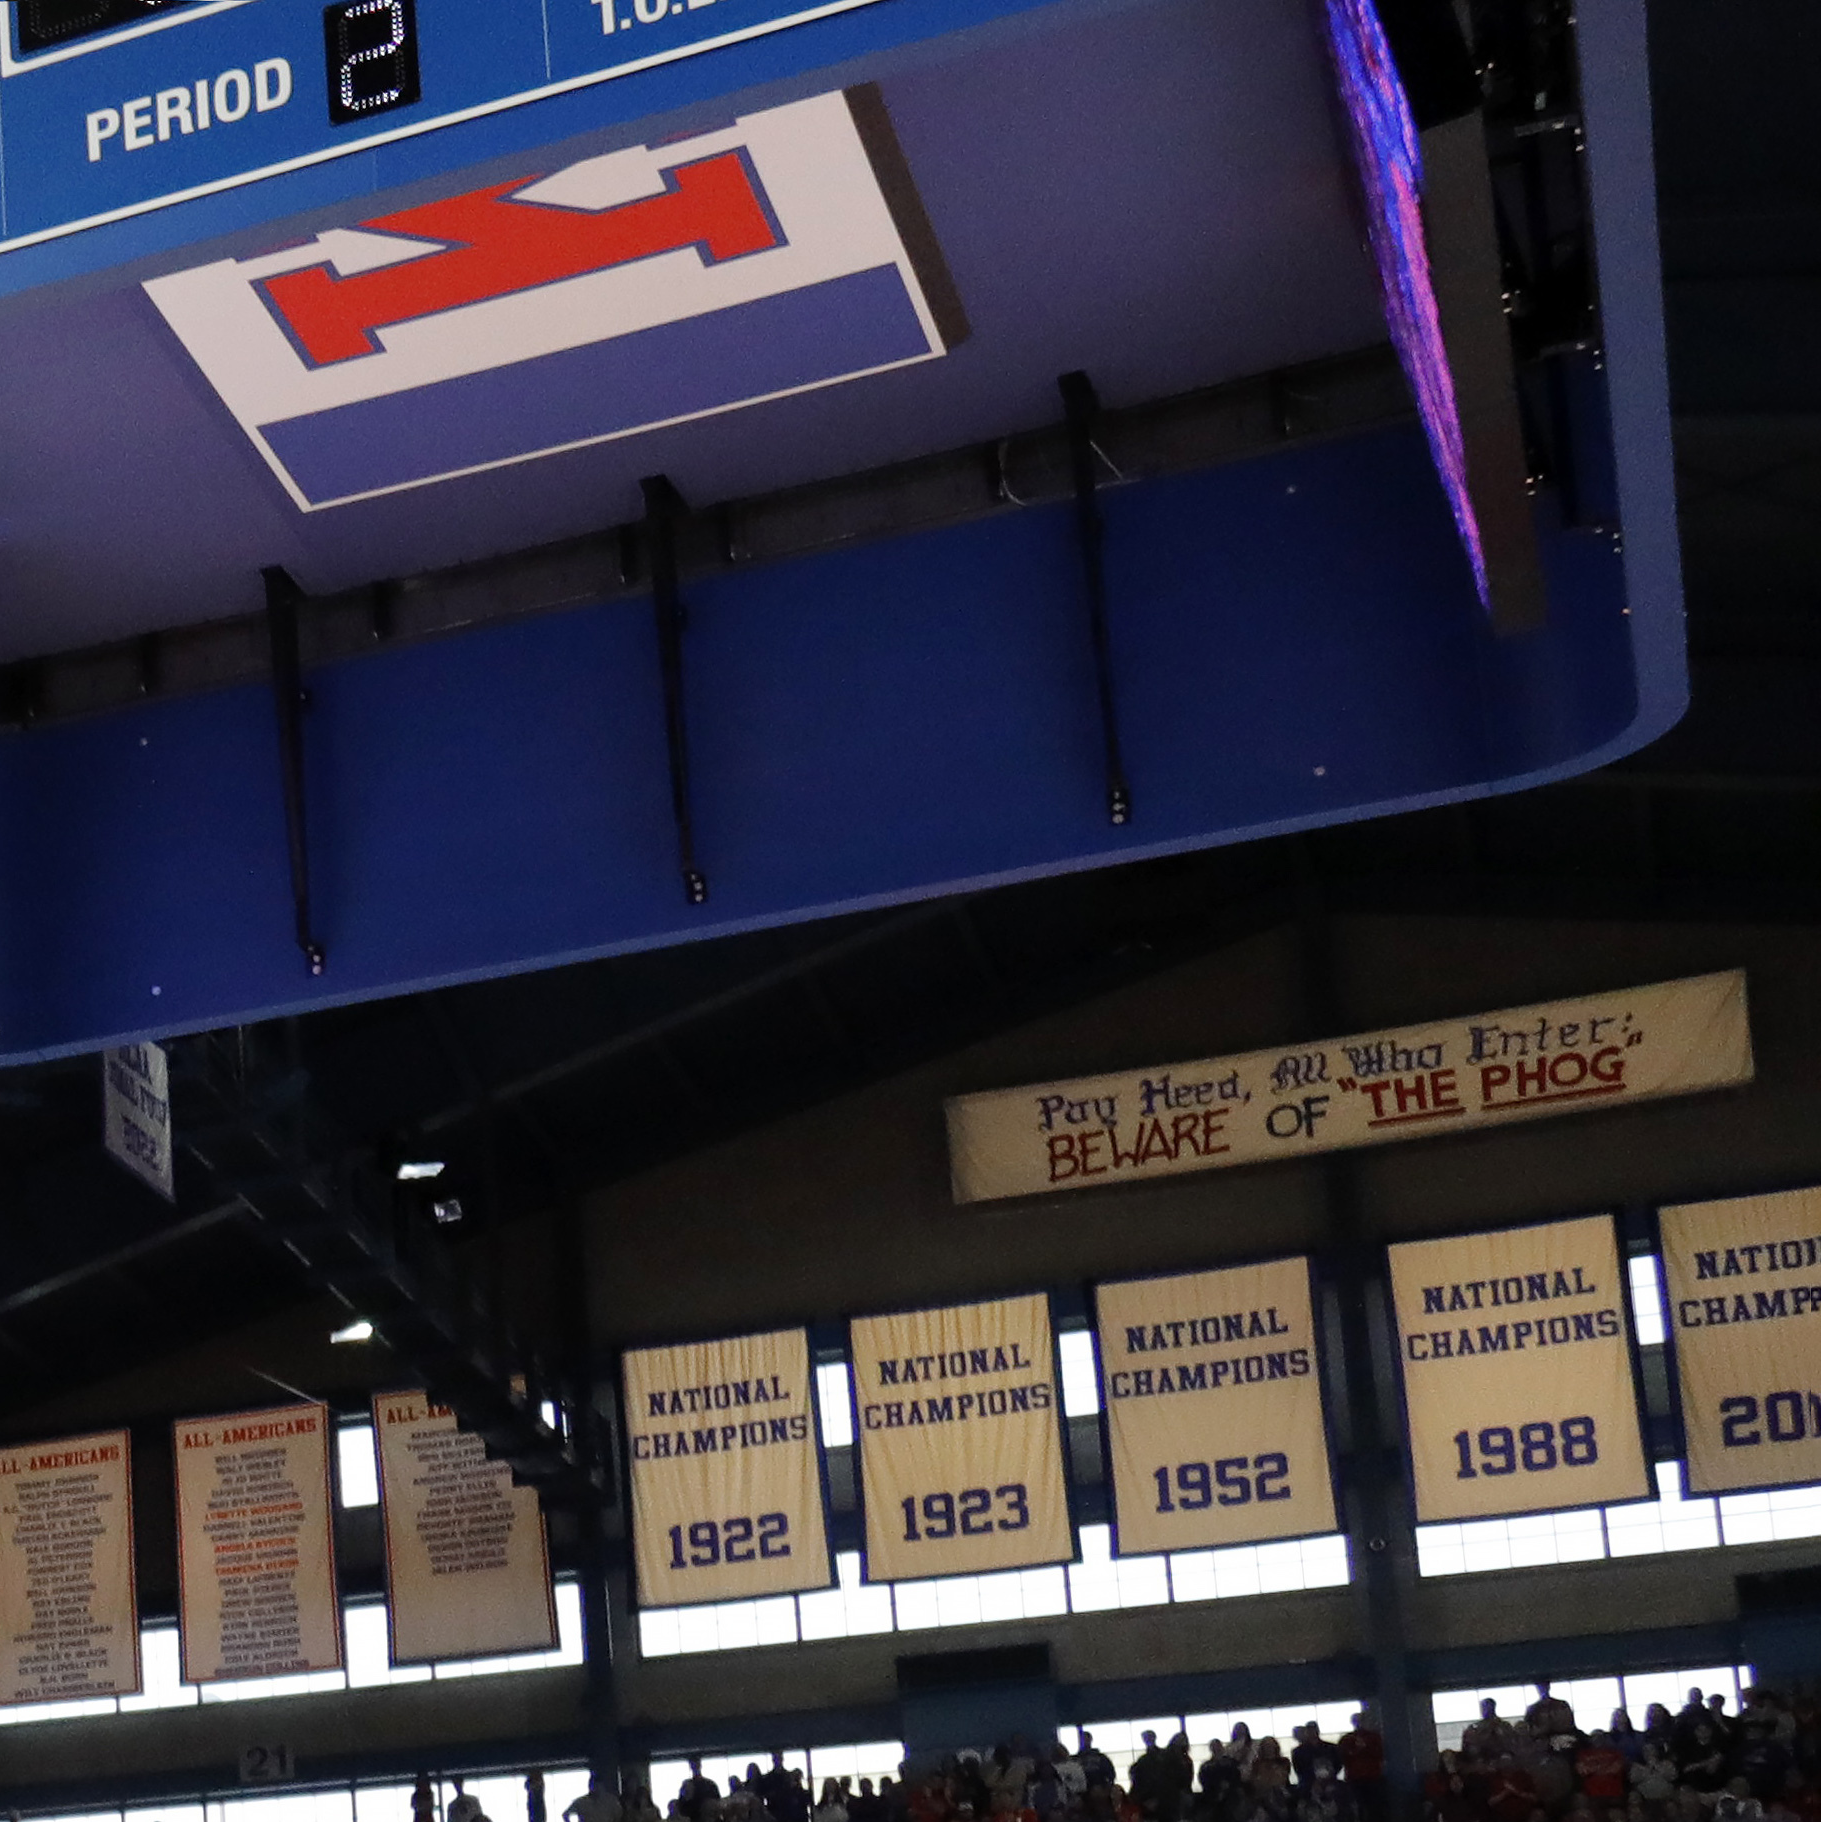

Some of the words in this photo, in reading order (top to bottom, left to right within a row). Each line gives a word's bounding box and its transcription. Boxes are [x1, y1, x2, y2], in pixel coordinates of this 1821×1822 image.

[84, 57, 293, 163] PERIOD
[1045, 1108, 1231, 1184] BEWARE
[1265, 1095, 1332, 1141] OF
[1421, 1267, 1596, 1314] NATIONAL
[1125, 1306, 1290, 1353] NATIONAL
[1407, 1309, 1620, 1363] CHAMPIONS
[878, 1343, 1031, 1386] NATIONAL
[1110, 1348, 1311, 1400] CHAMPIONS
[647, 1375, 791, 1417] NATIONAL
[864, 1382, 1052, 1432] CHAMPIONS
[183, 1418, 317, 1450] ALL-AMERICANS
[633, 1414, 808, 1461] CHAMPIONS
[1453, 1416, 1599, 1480] 1988
[1153, 1453, 1292, 1514] 1952
[901, 1483, 1031, 1542] 1923
[668, 1511, 791, 1570] 1922
